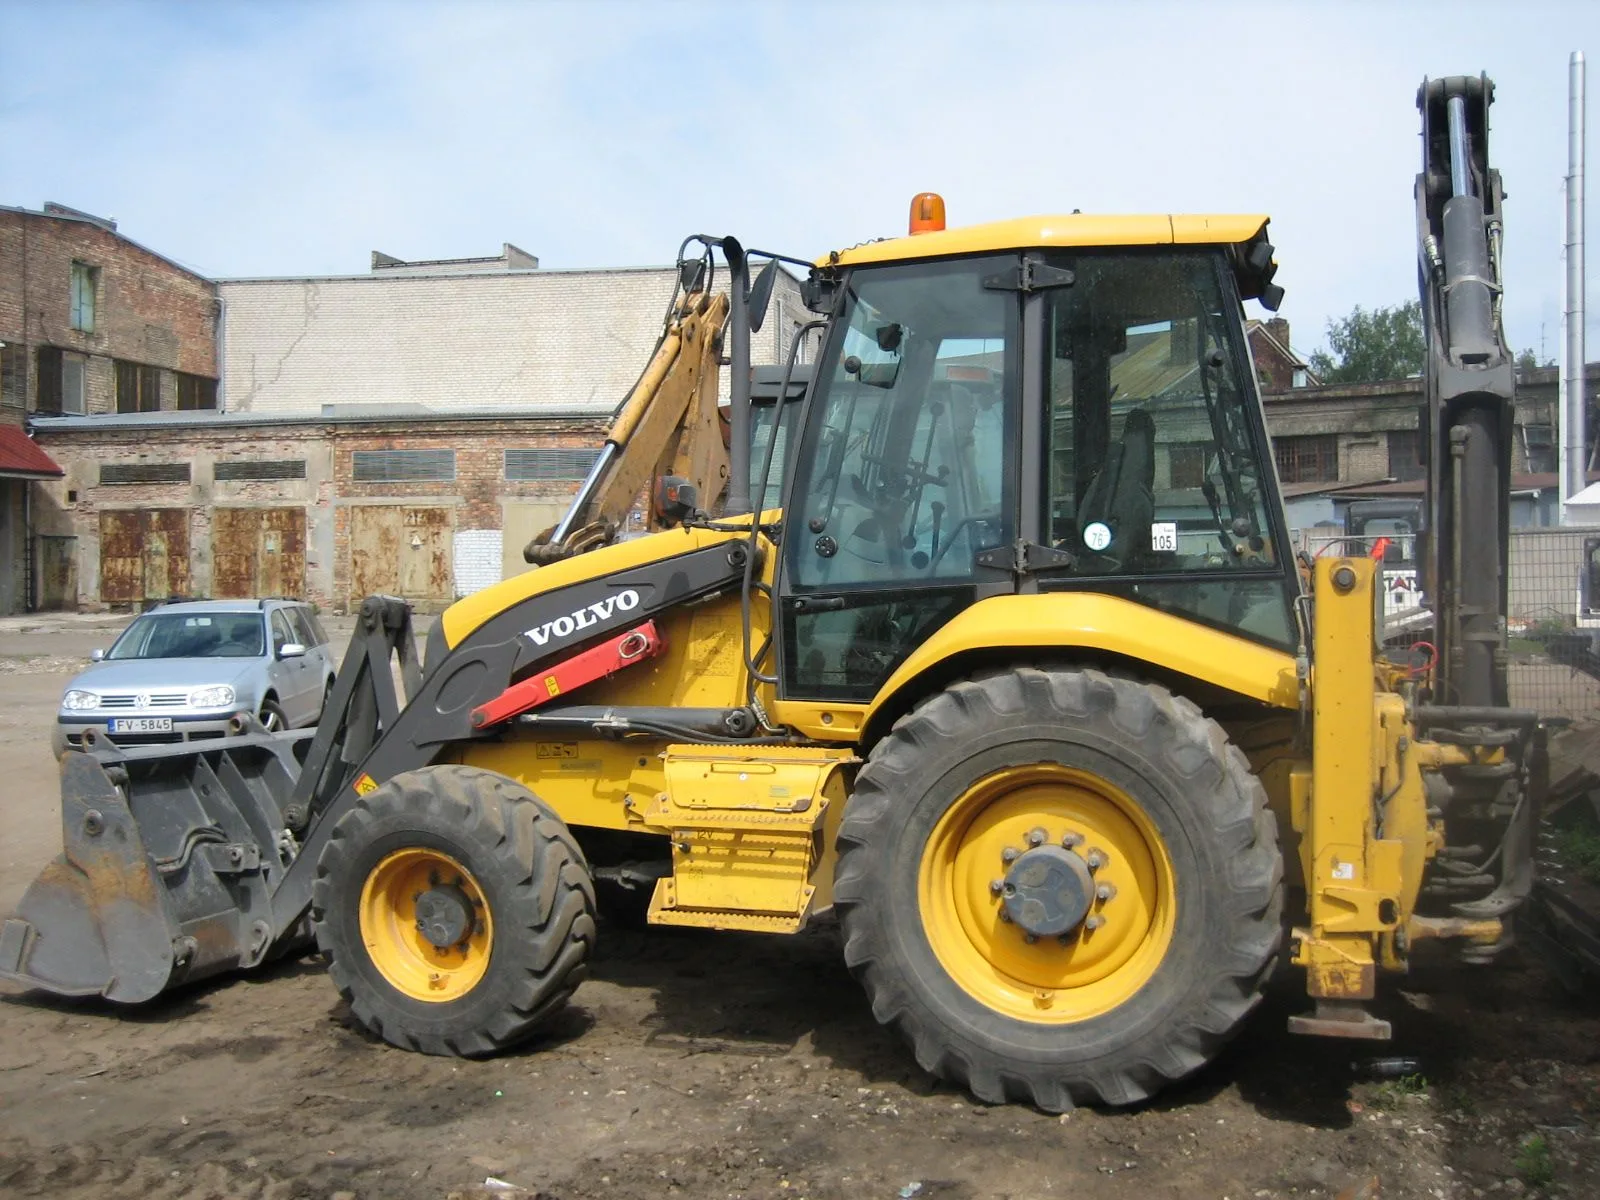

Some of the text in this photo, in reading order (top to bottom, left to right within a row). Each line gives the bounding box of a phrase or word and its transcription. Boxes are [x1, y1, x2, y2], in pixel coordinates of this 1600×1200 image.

[1153, 535, 1172, 549] 105
[524, 589, 640, 646] VOLVO
[117, 719, 170, 731] FV-5845
